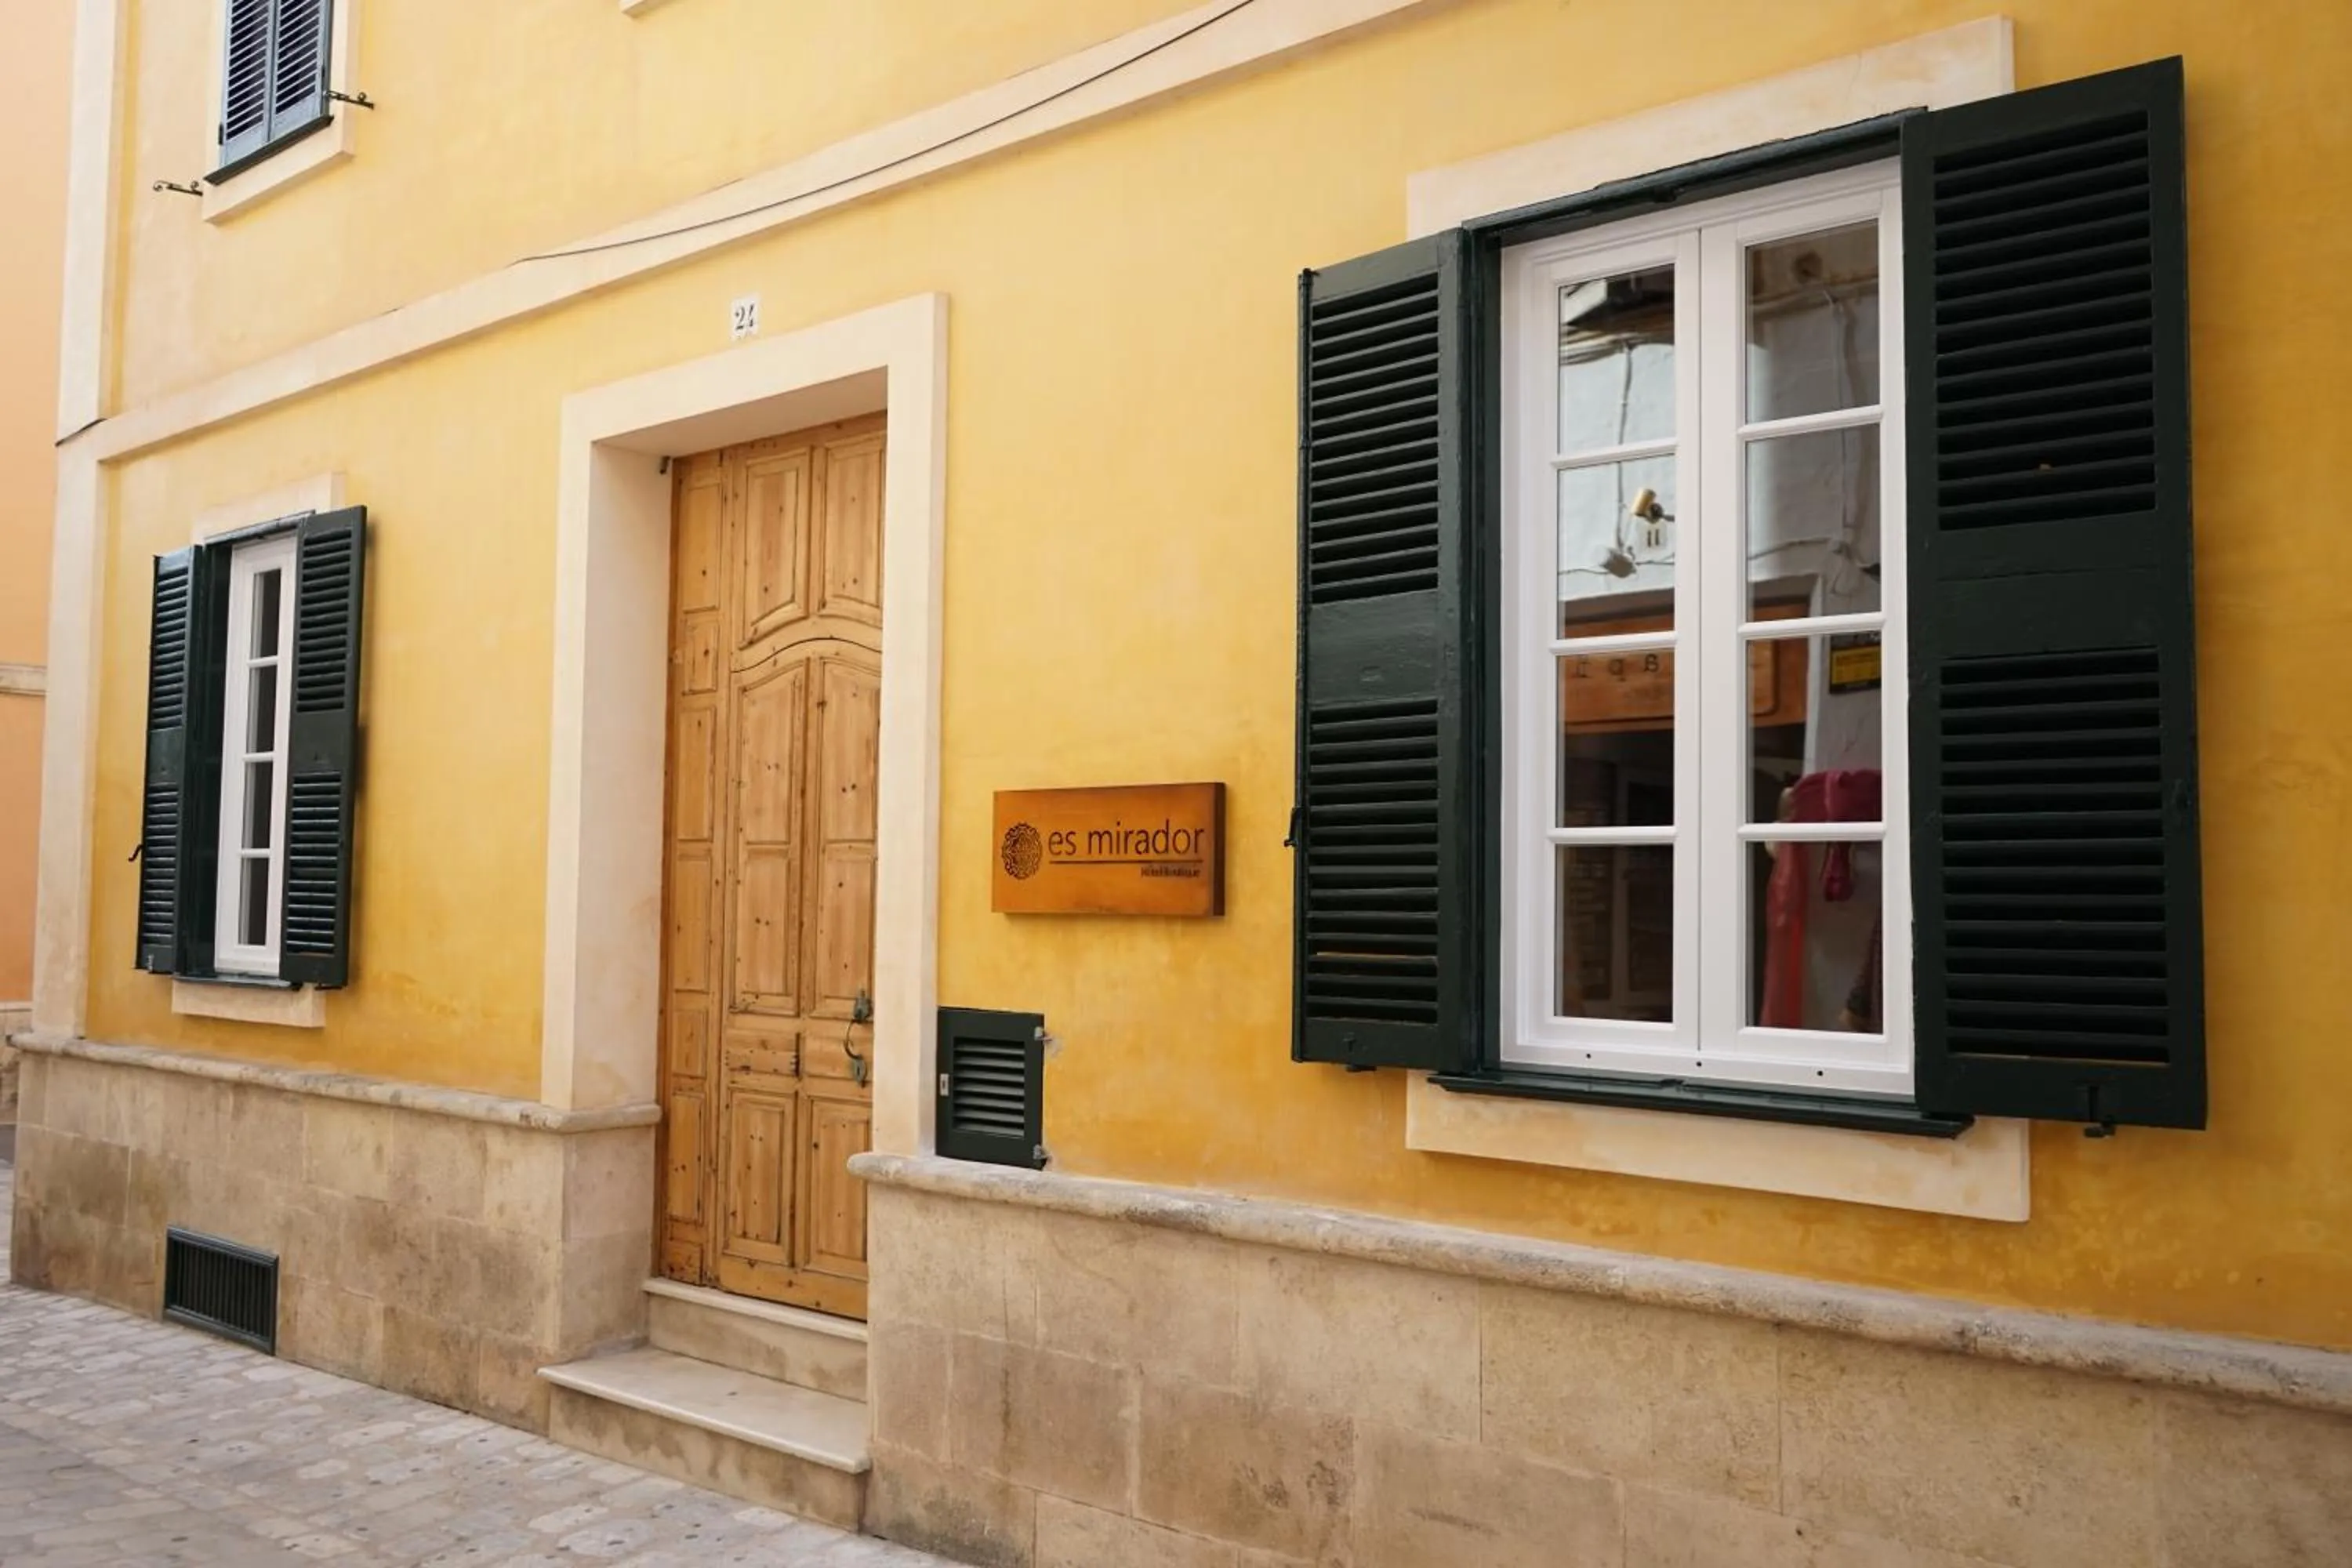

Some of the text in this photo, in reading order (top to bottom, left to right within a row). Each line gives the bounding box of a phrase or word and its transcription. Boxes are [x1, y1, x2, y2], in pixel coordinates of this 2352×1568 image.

[735, 304, 754, 330] 24
[1048, 818, 1204, 856] es mirador
